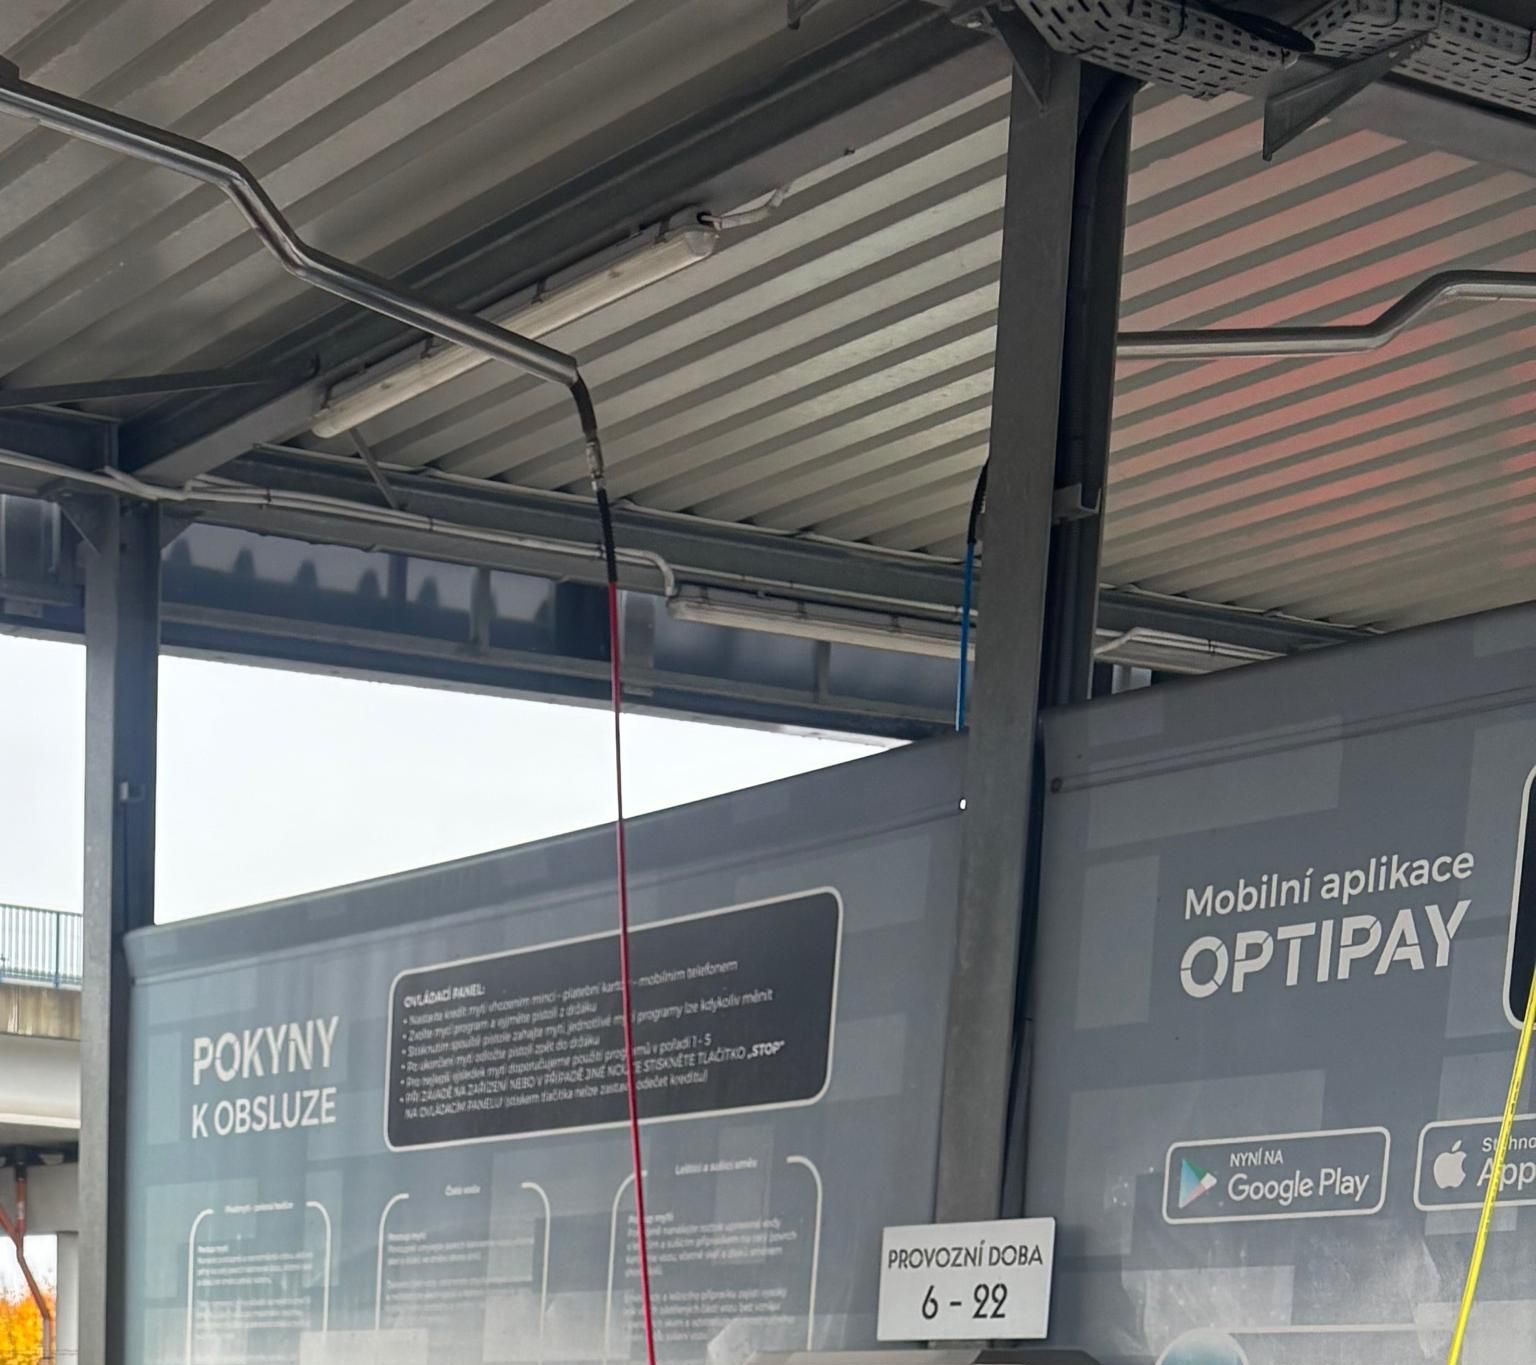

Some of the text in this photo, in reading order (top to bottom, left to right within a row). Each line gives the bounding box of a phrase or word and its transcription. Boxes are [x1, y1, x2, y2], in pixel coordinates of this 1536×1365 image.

[1184, 851, 1475, 920] Mobilní aplikace
[1180, 900, 1472, 998] OPTIPAY
[193, 1015, 339, 1086] POKYNY
[192, 1087, 337, 1138] K OBSLUZE
[1229, 1148, 1284, 1168] NYNÍ NA
[1482, 1136, 1536, 1152] Sthno
[1228, 1167, 1370, 1206] Google Play
[888, 1239, 1043, 1270] PROVOZNÍ DOBA
[922, 1285, 939, 1320] 6
[972, 1283, 1008, 1319] 22
